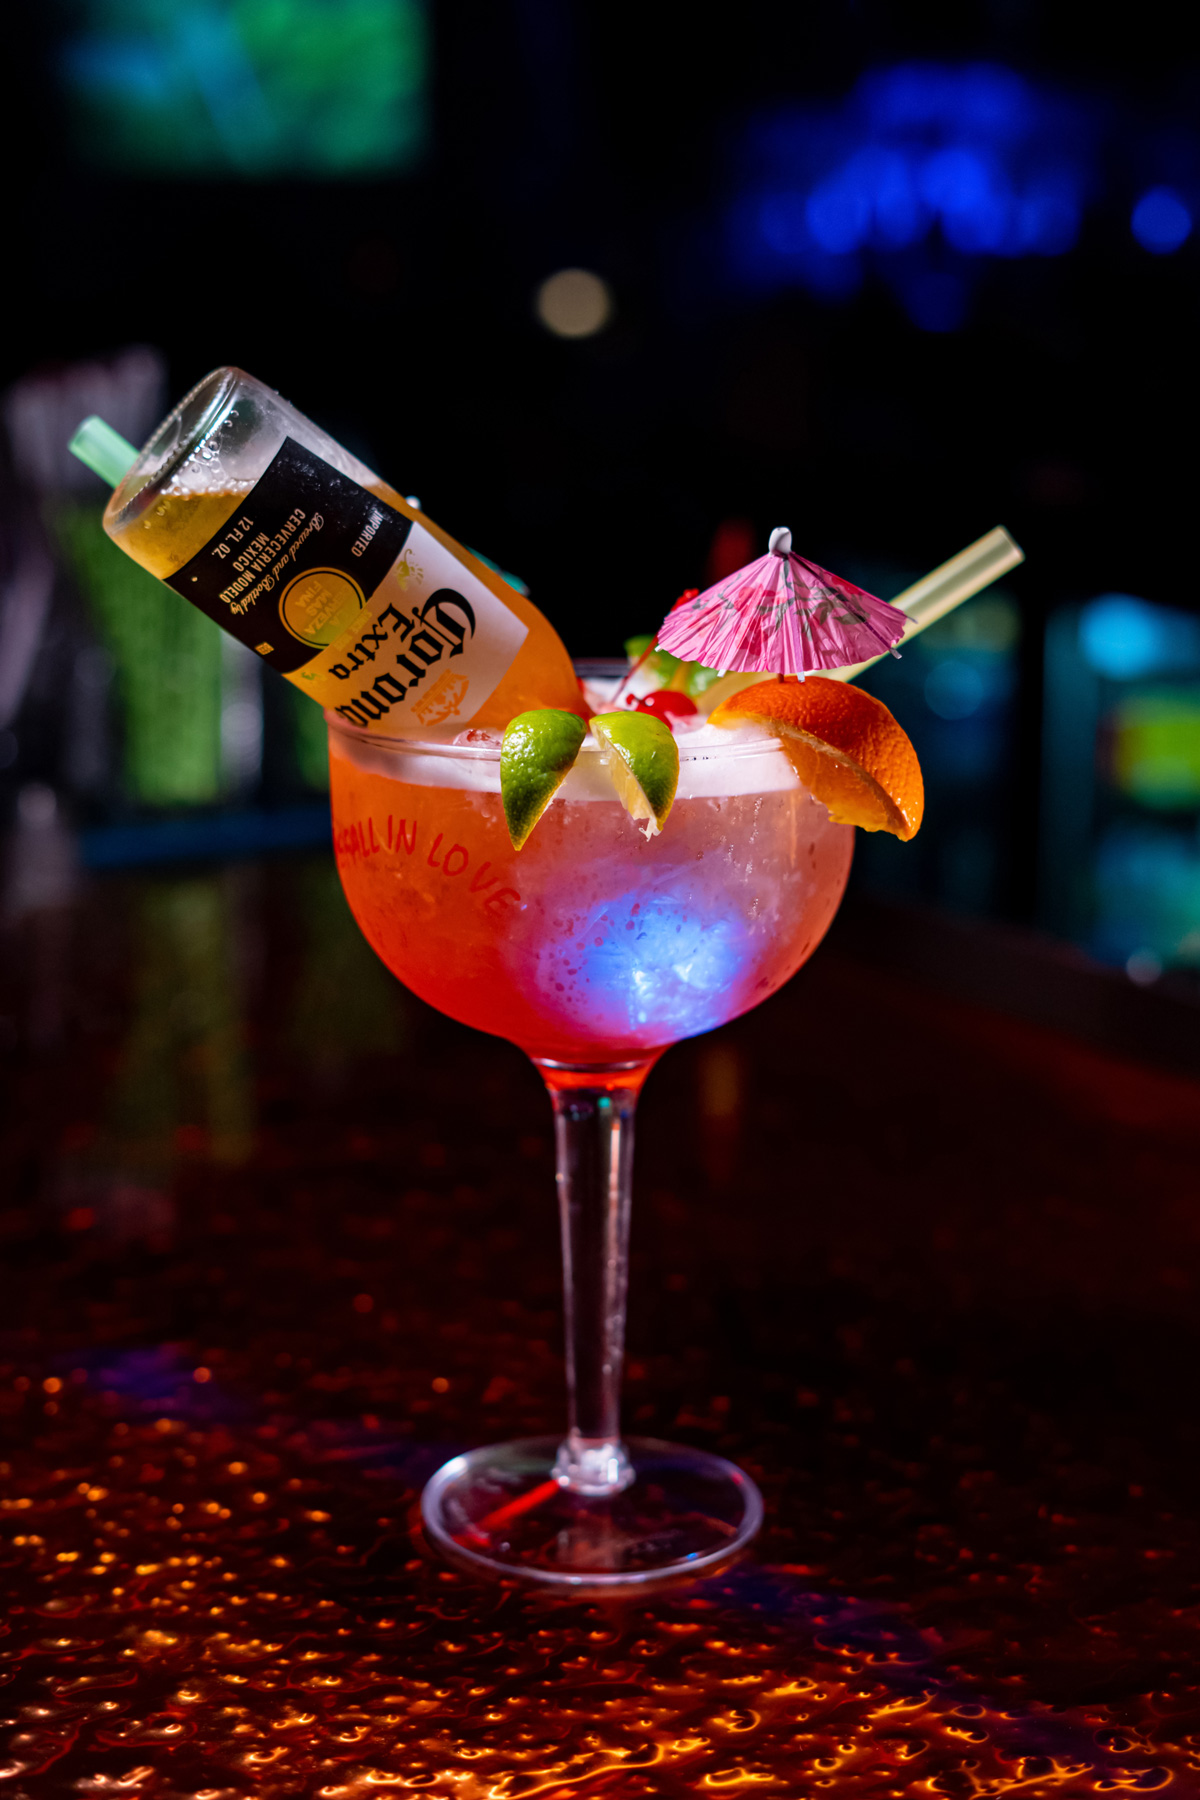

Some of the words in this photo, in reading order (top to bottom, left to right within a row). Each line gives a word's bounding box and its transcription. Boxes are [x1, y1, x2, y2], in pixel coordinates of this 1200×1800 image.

[225, 528, 244, 543] FL.
[238, 516, 254, 531] 12
[250, 508, 306, 572] CERVECERIA
[289, 512, 324, 562] Brewed
[351, 509, 384, 557] IMPORTED
[211, 543, 231, 559] OZ.
[232, 532, 270, 572] MEXICO
[272, 554, 289, 581] and
[219, 570, 256, 603] MODELO
[240, 574, 275, 612] Bottled
[295, 580, 321, 608] FINA
[230, 602, 245, 615] by
[328, 603, 415, 680] Extra
[335, 588, 476, 728] Corona
[388, 815, 417, 855] IN
[427, 833, 521, 918] LOVE
